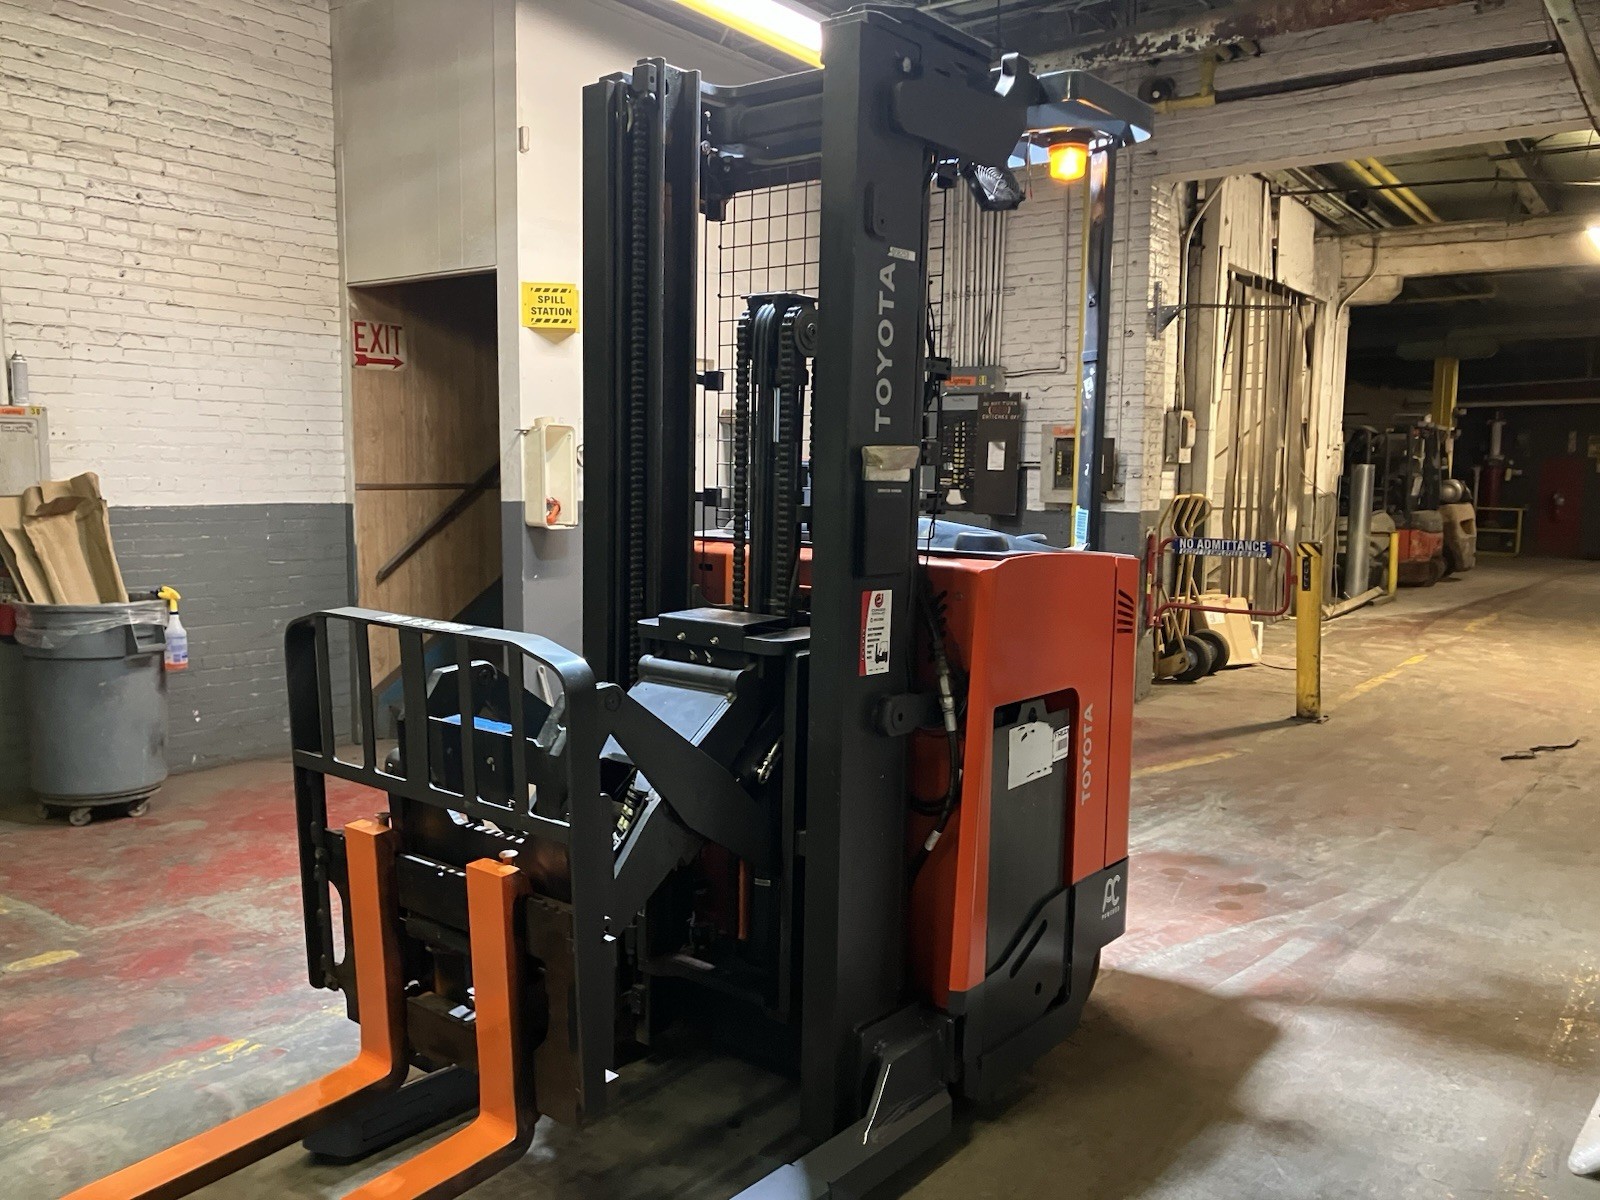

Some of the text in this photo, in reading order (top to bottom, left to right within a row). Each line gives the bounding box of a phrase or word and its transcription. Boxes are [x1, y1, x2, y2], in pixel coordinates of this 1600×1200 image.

[530, 306, 573, 316] STATION
[537, 295, 566, 305] SPILL
[353, 321, 403, 356] EXIT
[874, 262, 896, 432] TOYOTA
[1179, 538, 1268, 552] NO ADMITTANCE
[1081, 703, 1094, 806] TOYOTA
[1102, 874, 1121, 913] AC
